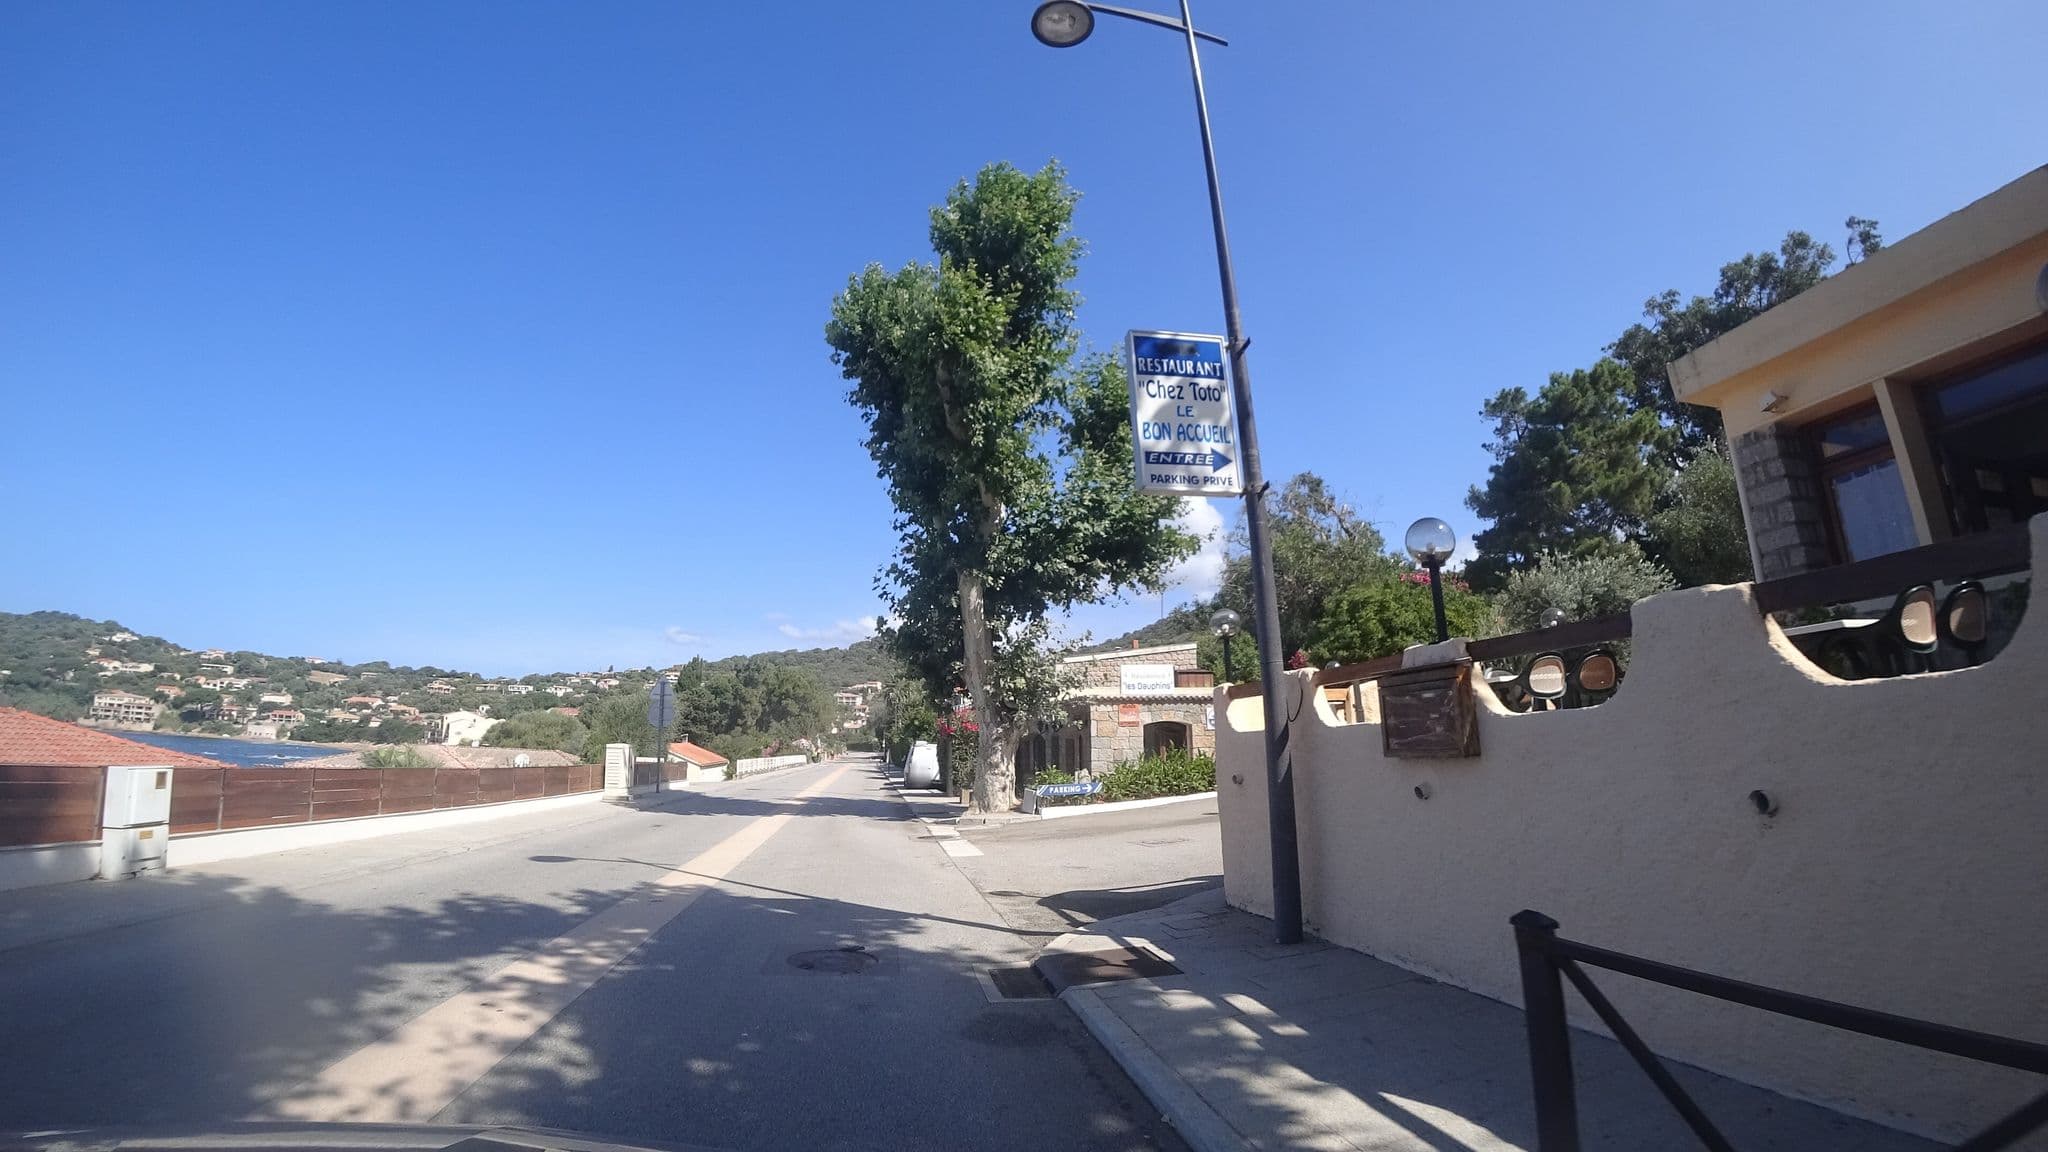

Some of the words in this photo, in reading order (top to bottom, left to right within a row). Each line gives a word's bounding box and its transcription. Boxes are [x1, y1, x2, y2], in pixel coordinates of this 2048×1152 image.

[1138, 357, 1222, 377] RESTAURANT
[1138, 380, 1185, 400] "Chez
[1189, 382, 1226, 402] Toto"
[1176, 405, 1195, 418] LE
[1142, 422, 1172, 441] BON
[1176, 423, 1232, 444] ACCUEIL
[1149, 453, 1215, 465] ENTREE
[1150, 473, 1200, 485] PARKING
[1049, 785, 1081, 794] PARKING
